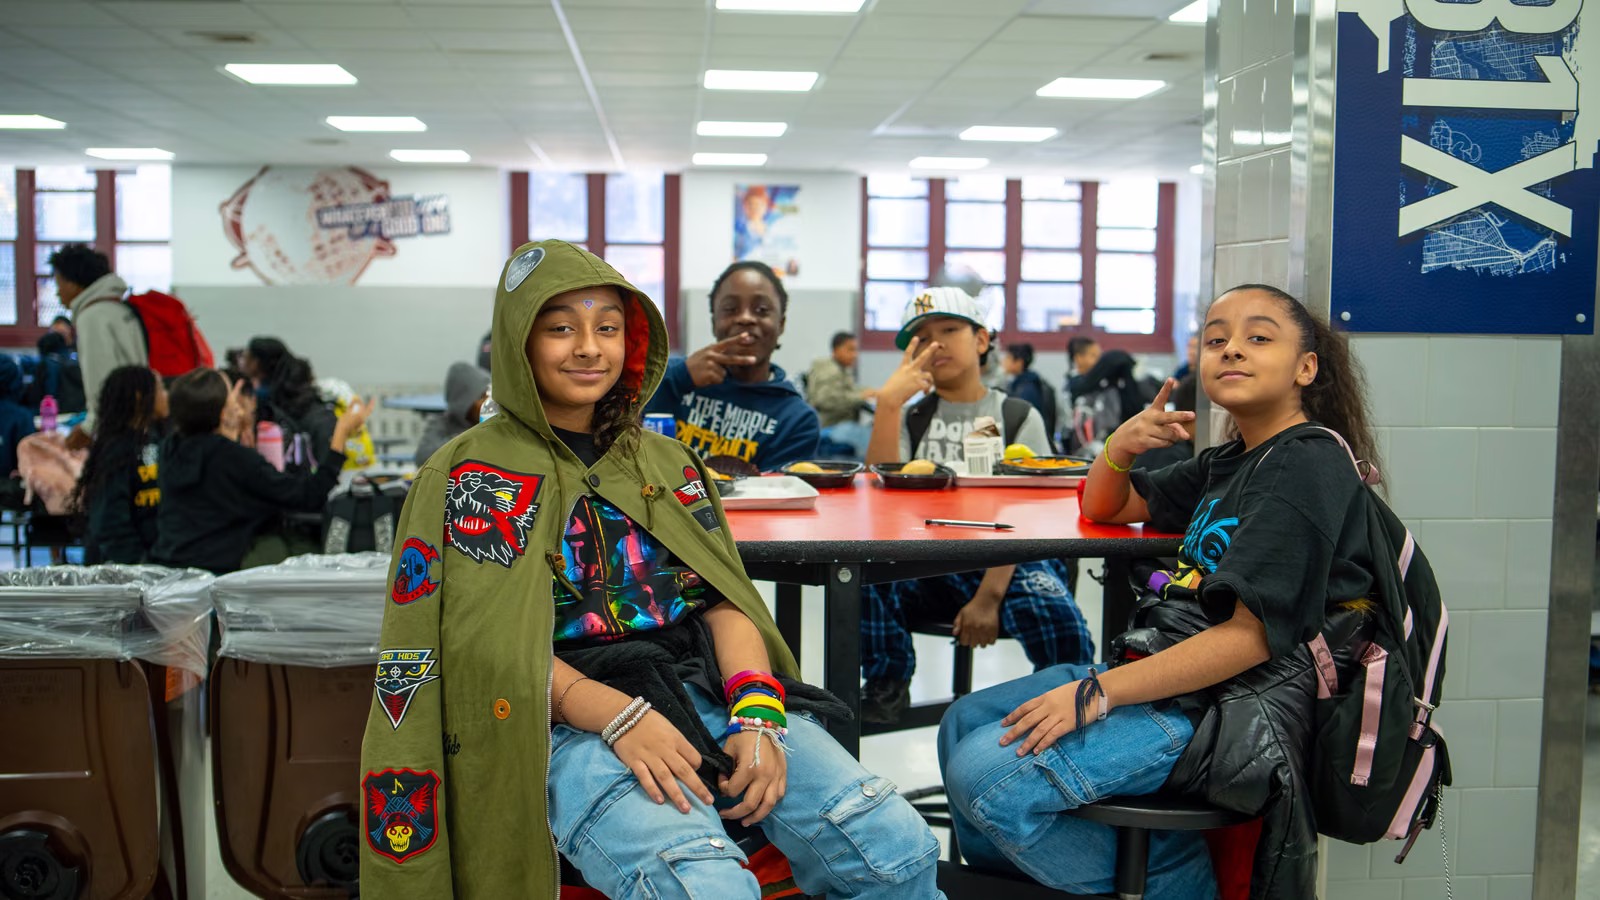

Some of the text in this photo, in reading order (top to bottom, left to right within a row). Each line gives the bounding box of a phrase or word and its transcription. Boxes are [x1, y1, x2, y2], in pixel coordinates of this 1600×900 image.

[687, 408, 707, 428] OF
[710, 416, 758, 441] EVERY
[696, 395, 724, 419] THE
[724, 402, 778, 435] MIDDLE
[397, 652, 421, 660] KIDS
